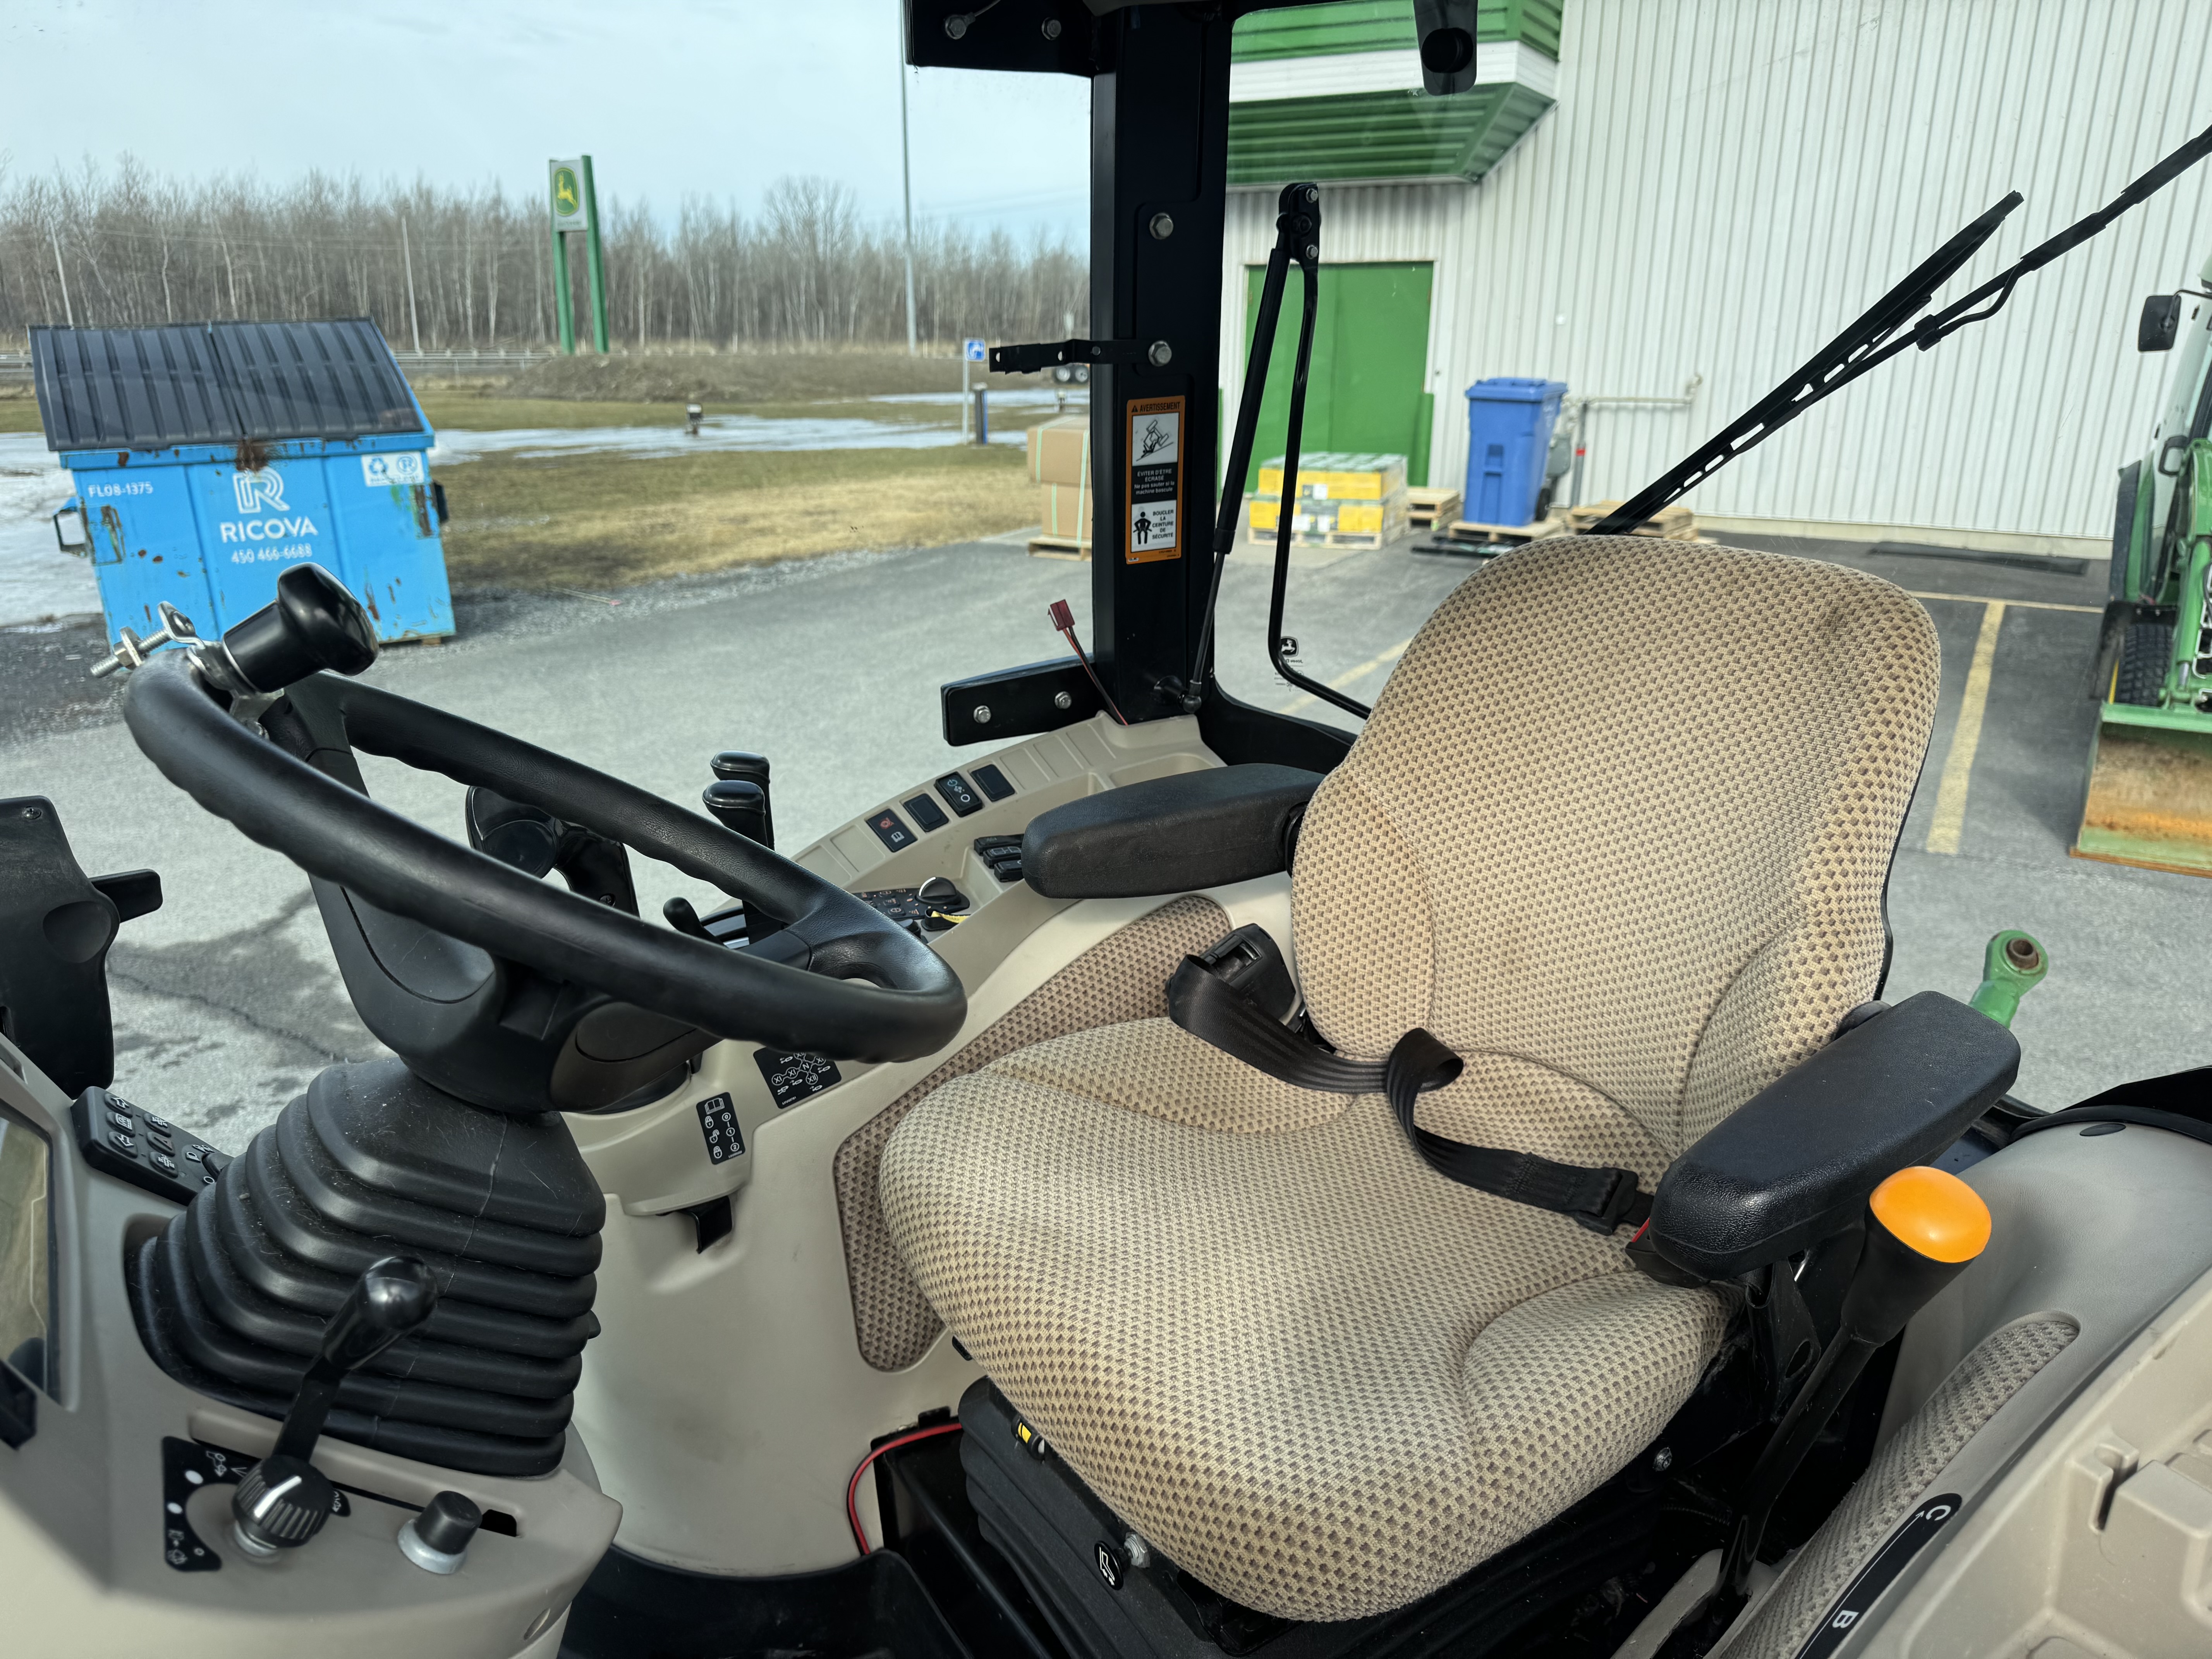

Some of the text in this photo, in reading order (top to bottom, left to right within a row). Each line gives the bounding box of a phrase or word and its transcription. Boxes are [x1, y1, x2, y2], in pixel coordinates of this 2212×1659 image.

[1140, 402, 1180, 412] AVERTISSEMENT
[220, 516, 318, 543] RICOVA
[231, 548, 255, 564] 450
[774, 1075, 782, 1084] XI
[807, 1075, 817, 1084] XII
[1925, 1504, 1952, 1522] C
[1832, 1610, 1859, 1629] B
